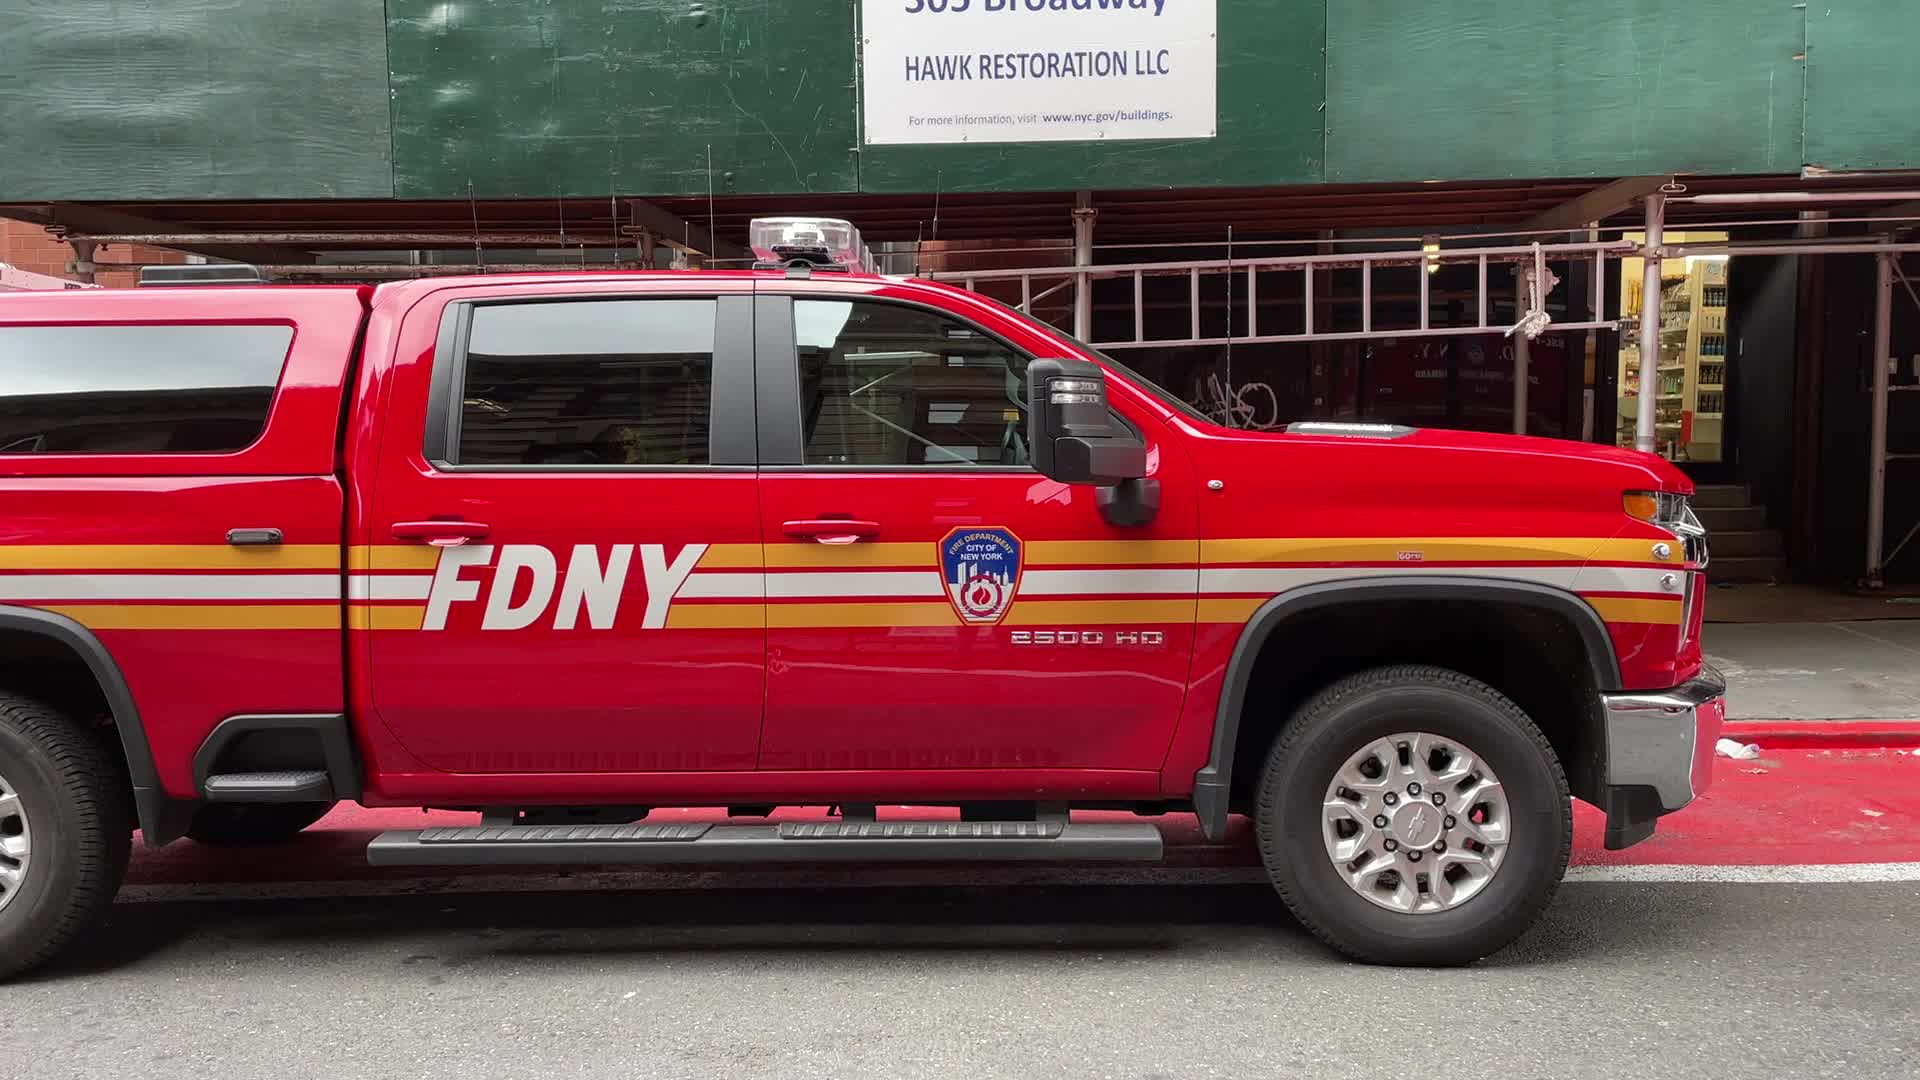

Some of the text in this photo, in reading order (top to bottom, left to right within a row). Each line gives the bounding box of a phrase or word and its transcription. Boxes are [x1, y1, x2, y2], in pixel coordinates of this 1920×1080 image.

[905, 50, 1170, 81] HAWK RESTORATION LLC
[909, 115, 925, 126] For
[927, 116, 953, 125] more
[1017, 112, 1037, 123] visit
[1042, 110, 1173, 123] www.nyc.gov/buildings.
[949, 533, 1014, 555] FIRE DEPARTMENT
[966, 544, 985, 552] CITY
[960, 553, 979, 561] NEW
[421, 543, 710, 631] FDNY
[1011, 631, 1163, 644] 2500 HD
